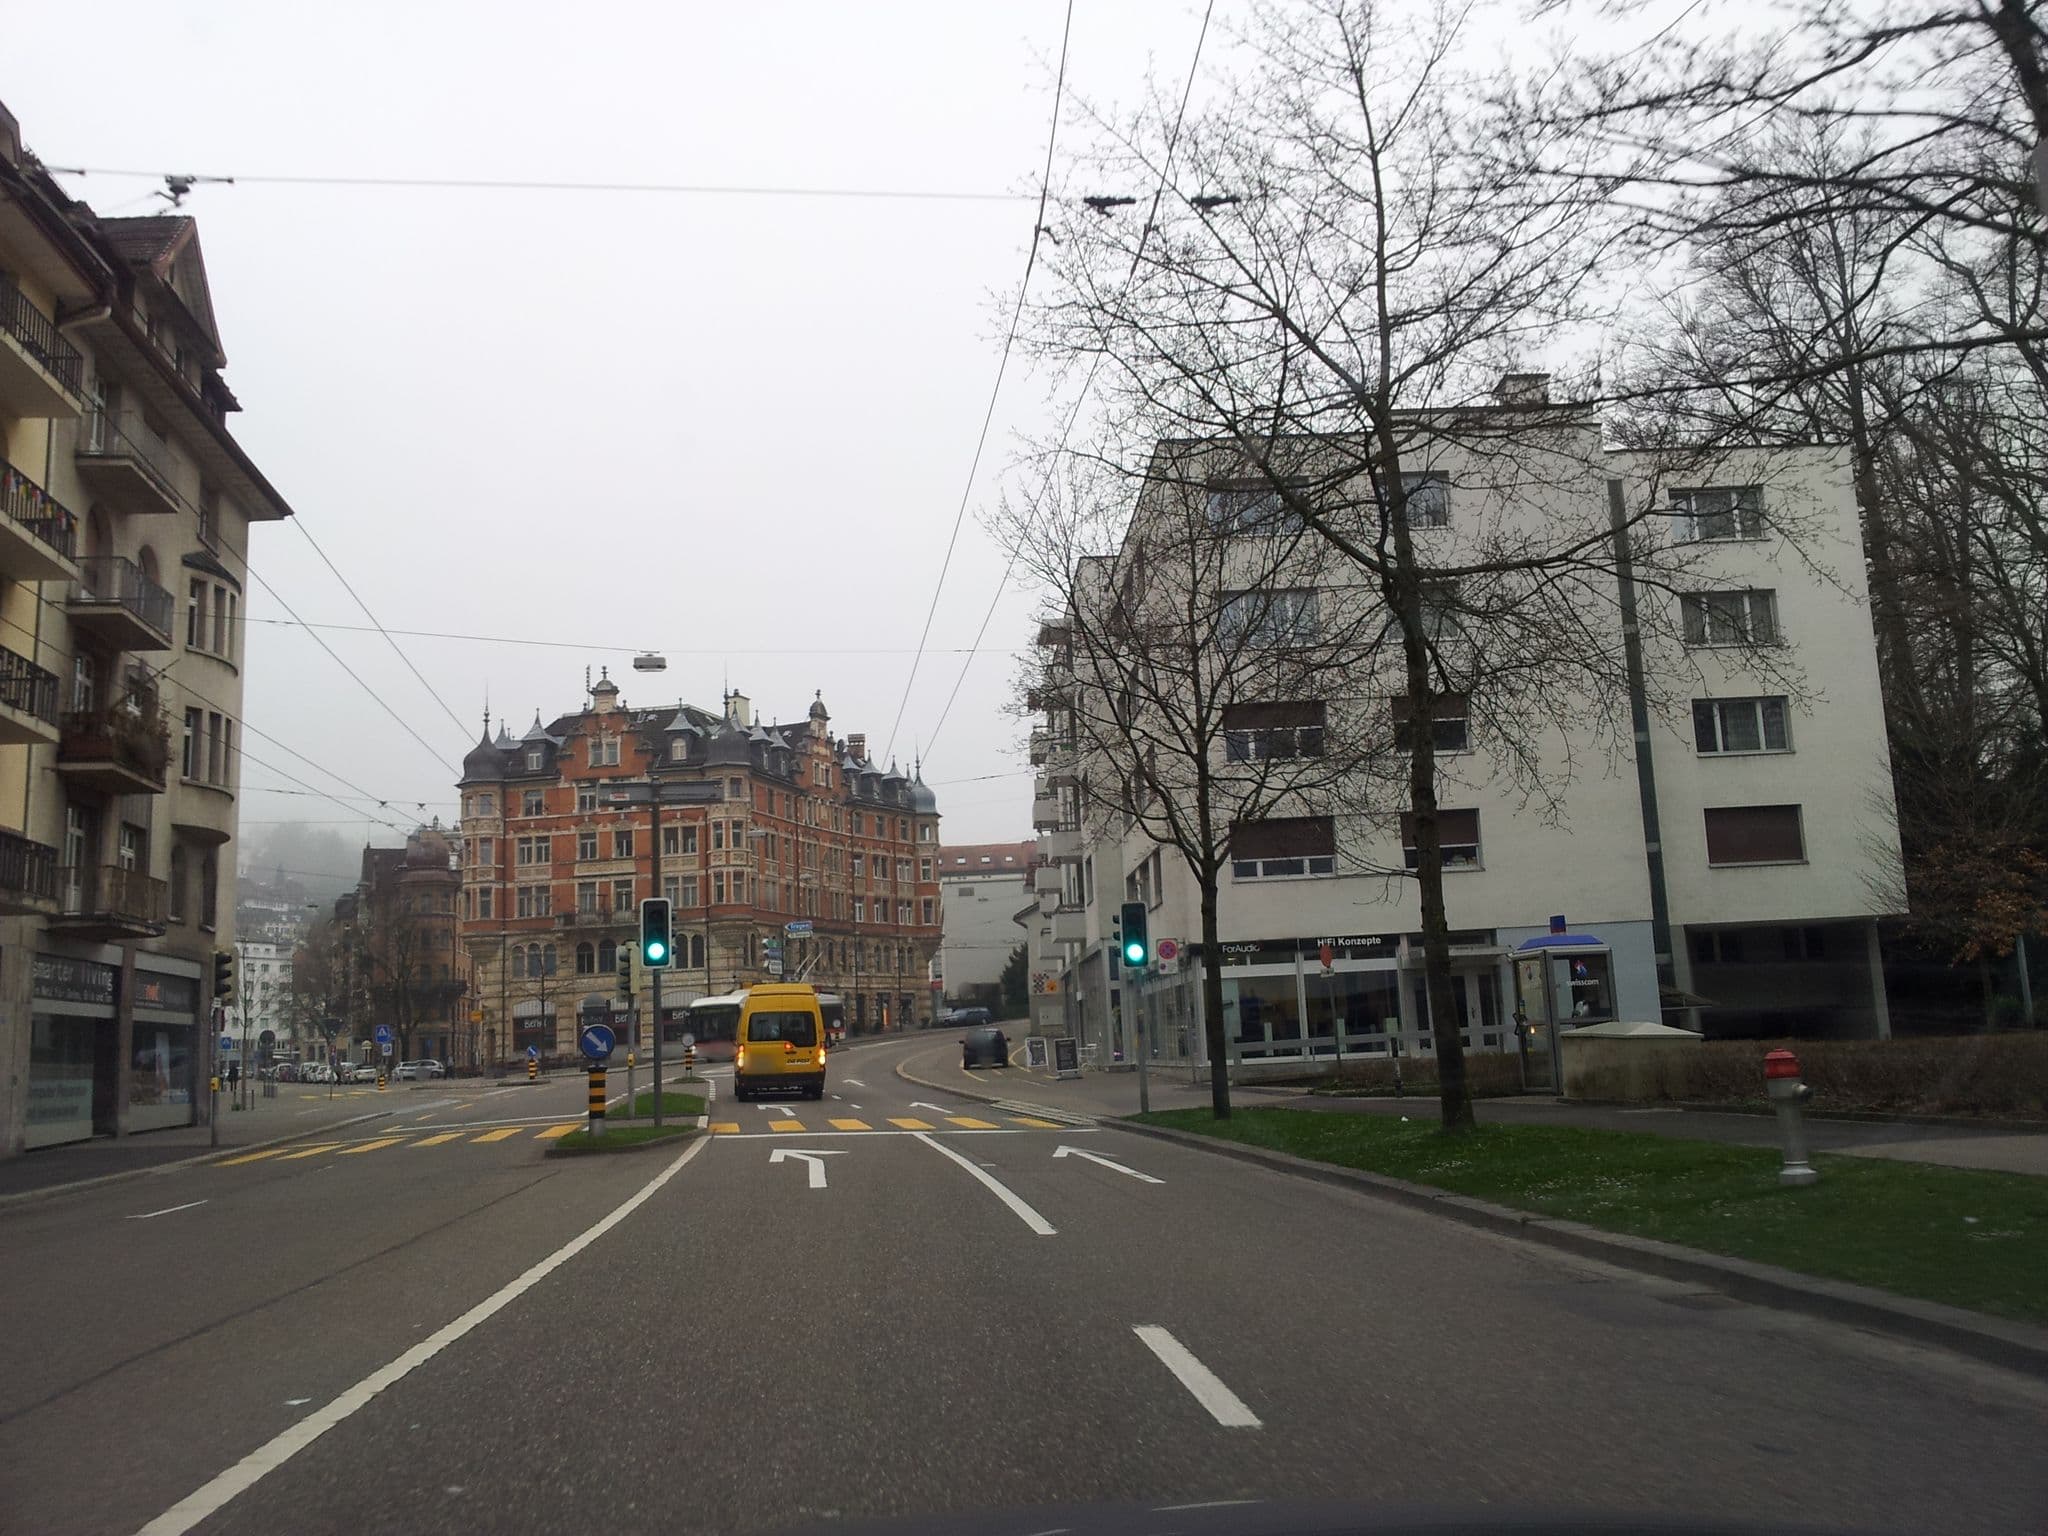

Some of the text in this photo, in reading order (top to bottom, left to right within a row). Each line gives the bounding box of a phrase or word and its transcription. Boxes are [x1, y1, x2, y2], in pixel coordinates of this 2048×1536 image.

[1338, 936, 1382, 947] Konzepte
[1222, 944, 1261, 954] ForAudio
[81, 961, 113, 992] living
[1566, 978, 1600, 987] swisscom
